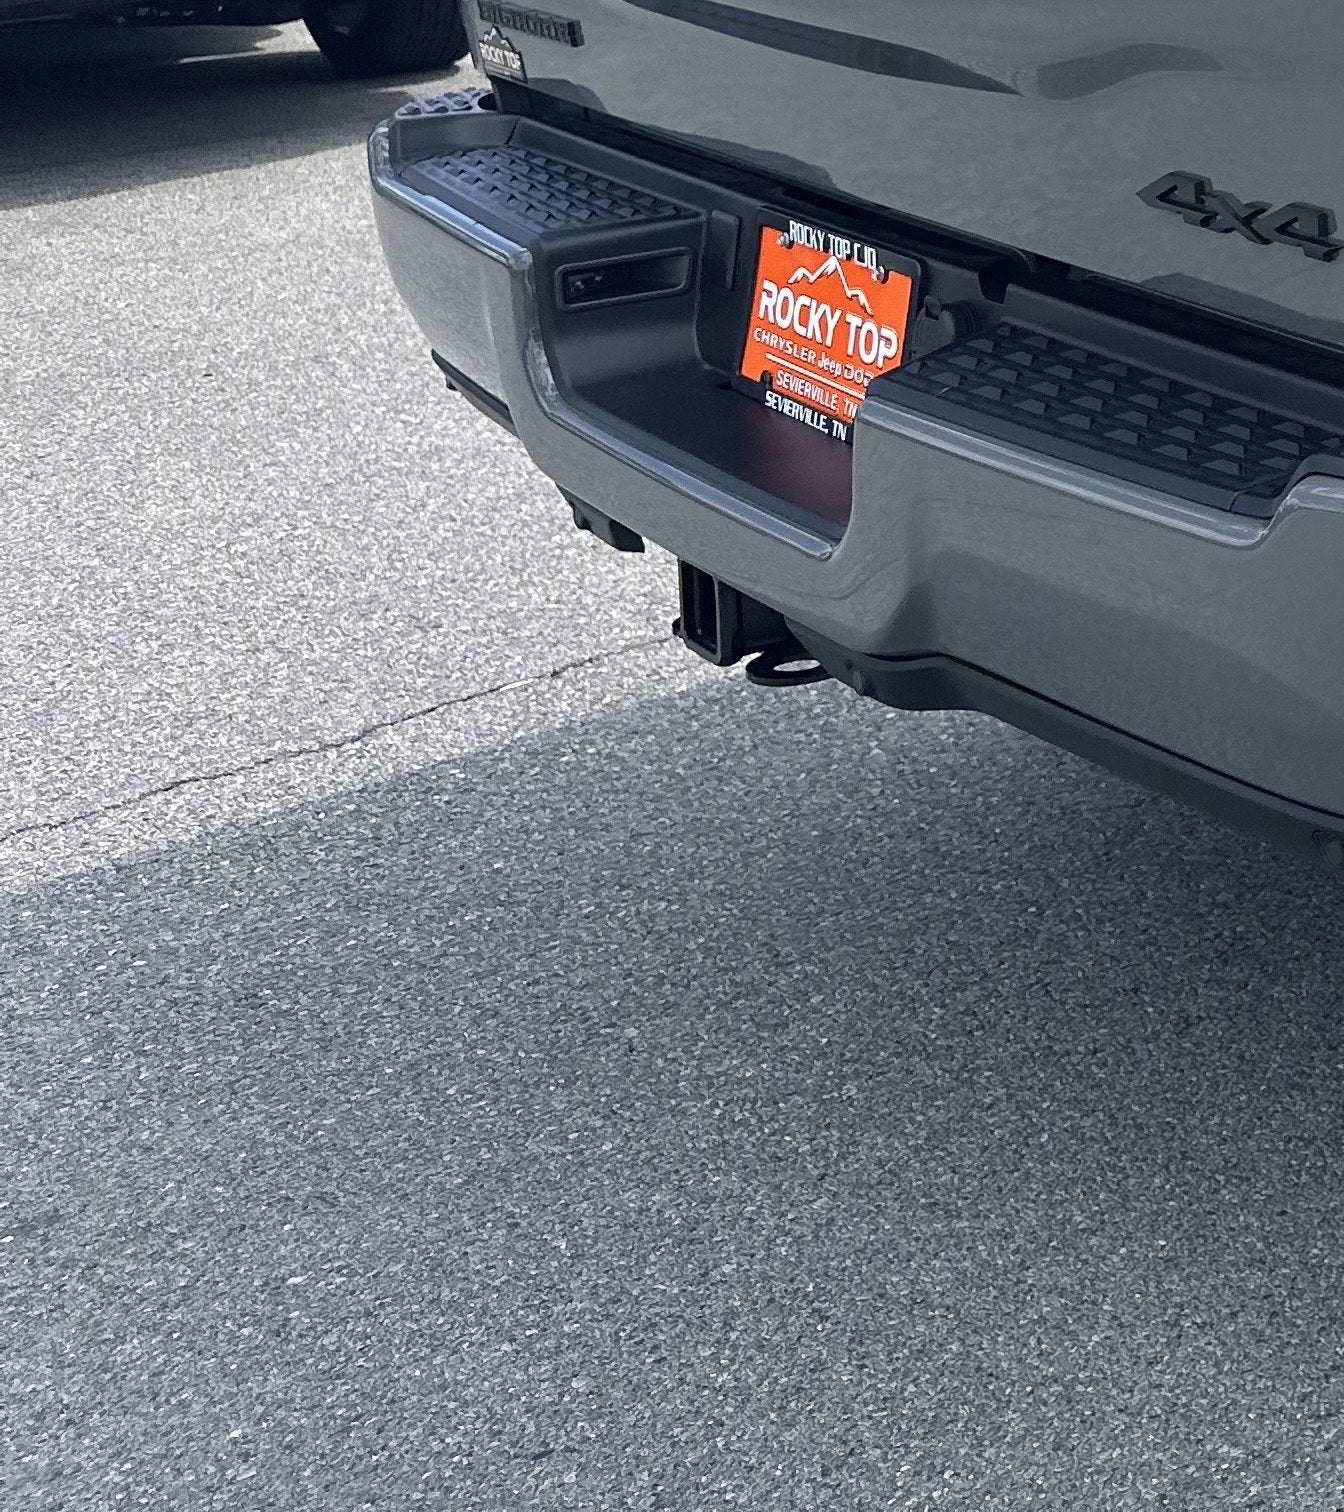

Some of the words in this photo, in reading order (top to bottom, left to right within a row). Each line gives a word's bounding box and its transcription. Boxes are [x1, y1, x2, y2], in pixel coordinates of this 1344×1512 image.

[789, 220, 825, 252] ROCKY
[828, 234, 851, 258] TOP
[758, 279, 842, 348] ROCKY
[846, 312, 899, 369] TOP
[754, 327, 817, 365] CHRYSLER
[818, 352, 842, 378] Jeep
[844, 398, 858, 418] TN
[833, 419, 847, 441] TN
